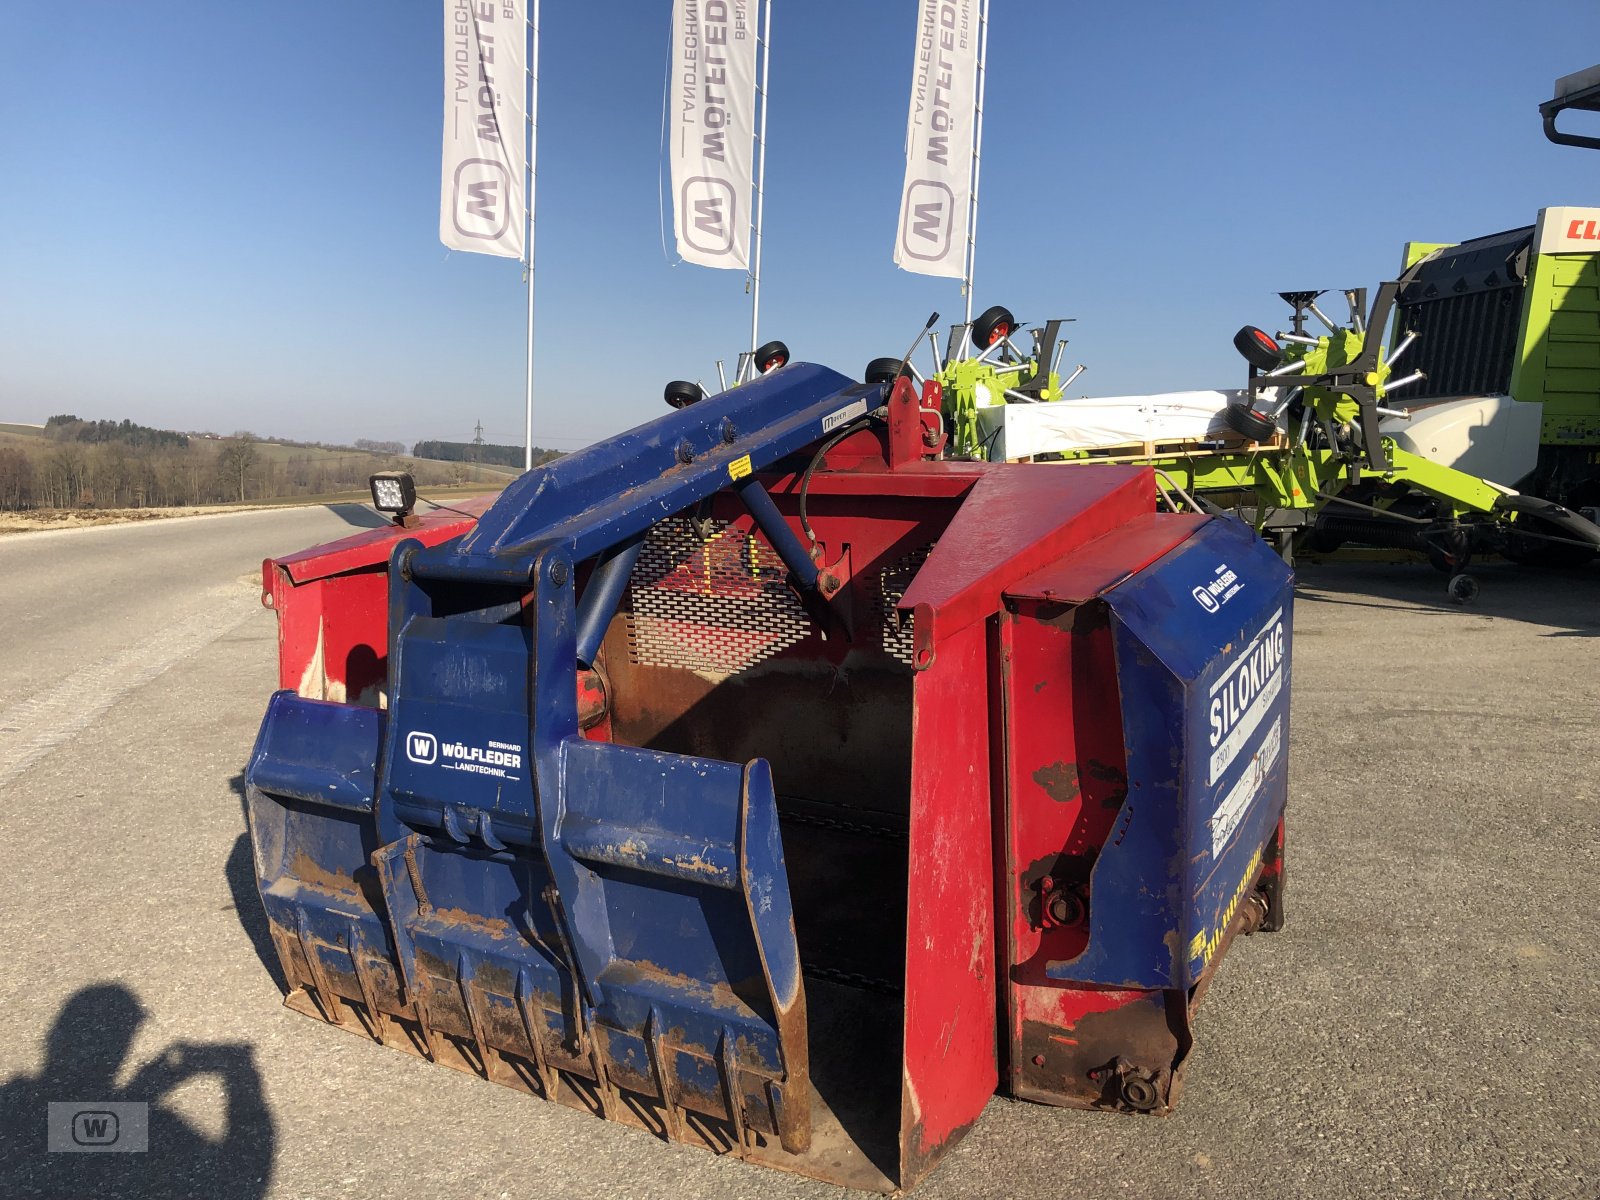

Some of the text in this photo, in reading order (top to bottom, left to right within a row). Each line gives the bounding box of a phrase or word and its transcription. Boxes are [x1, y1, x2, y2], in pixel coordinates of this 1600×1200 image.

[1567, 219, 1600, 240] CL
[1210, 622, 1283, 747] SILOKING
[413, 738, 431, 757] W
[442, 742, 521, 768] WÖLFLEDER
[488, 740, 522, 752] BERNHARD
[455, 762, 506, 778] LANDTECHNIK
